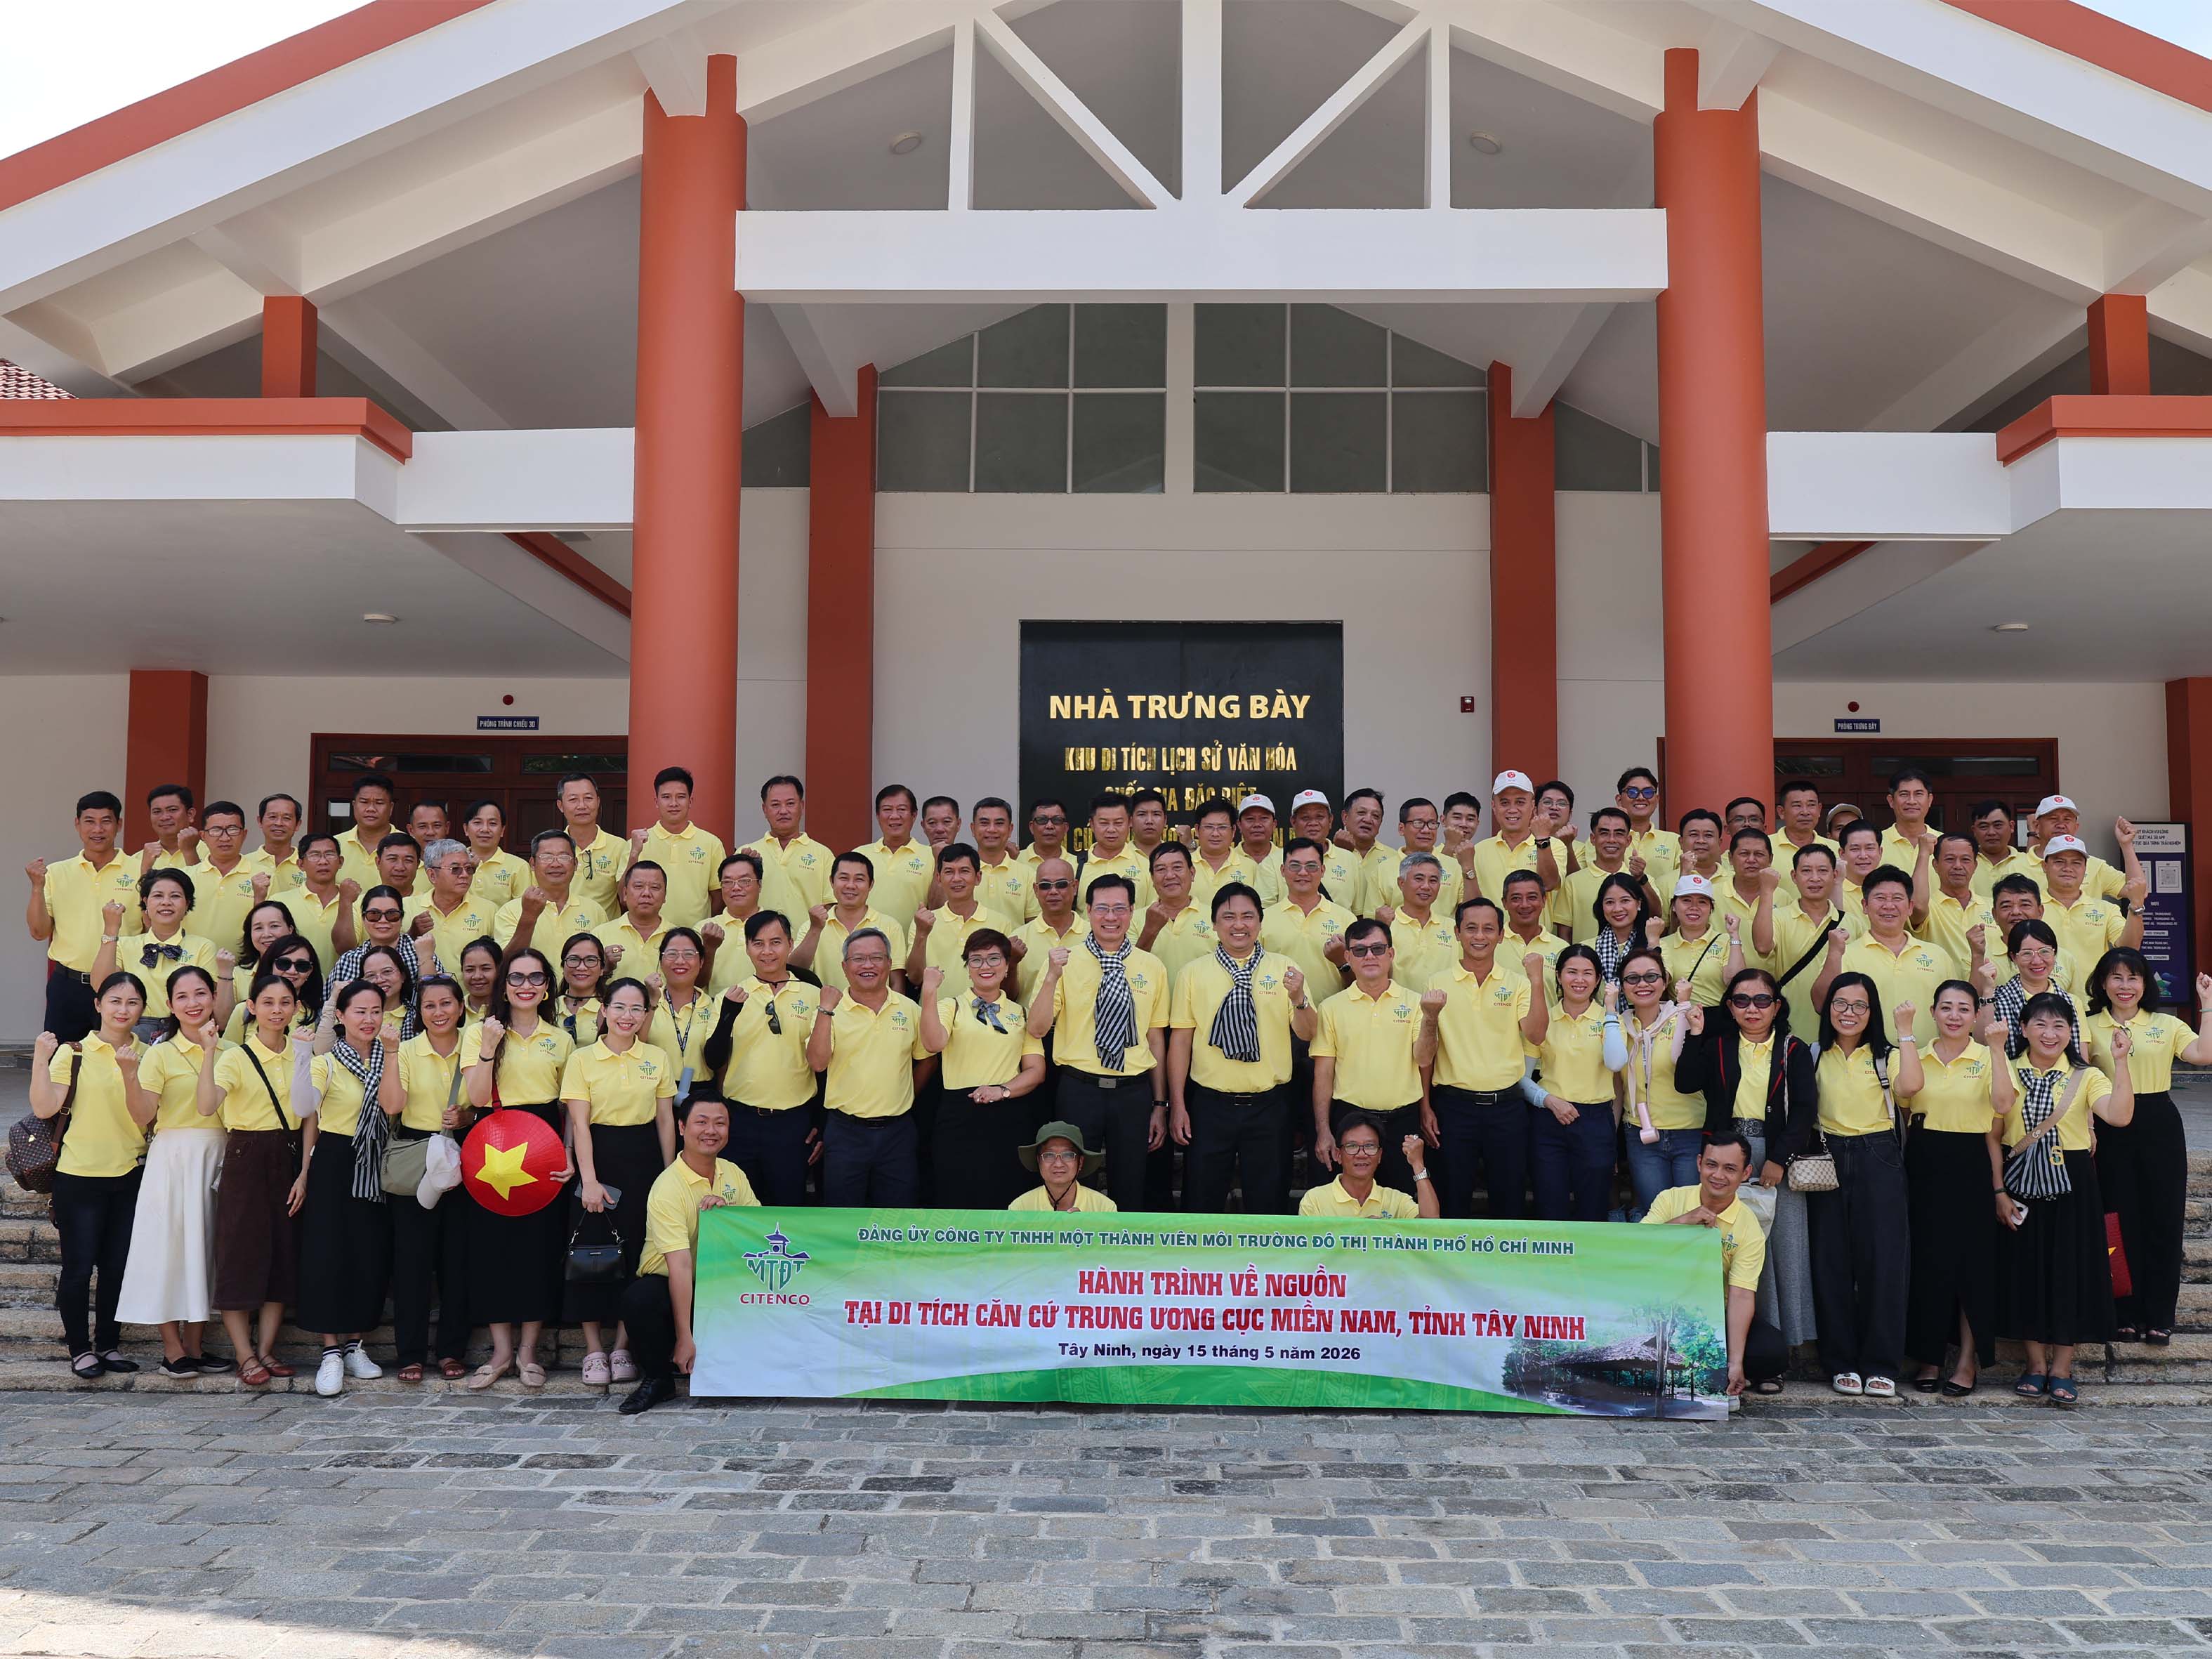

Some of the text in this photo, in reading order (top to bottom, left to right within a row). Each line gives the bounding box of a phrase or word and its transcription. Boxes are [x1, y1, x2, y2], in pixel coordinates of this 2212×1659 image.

[1050, 688, 1310, 719] NHÀ TRƯNG BÀY
[1065, 740, 1297, 775] KHU DI TÍCH LỊCH SỬ VĂN HÓA
[858, 1224, 1574, 1254] ĐẢNG ỦY CÔNG TY TNHH MỘT THÀNH VIÊN MÔI TRƯỜNG ĐÔ THỊ THÀNH PHỐ HỒ CHÍ MINH
[1079, 1264, 1346, 1297] HÀNH TRÌNH VỀ NGUỒN
[740, 1293, 810, 1305] CITENCO
[845, 1299, 1585, 1340] TẠI DI TÍCH CĂN CỨ TRUNG ƯƠNG CỤC MIỀN NAM, TỈNH TÂY NINH
[1058, 1343, 1360, 1360] Tây Ninh, ngày 15 tháng 5 năm 2026
